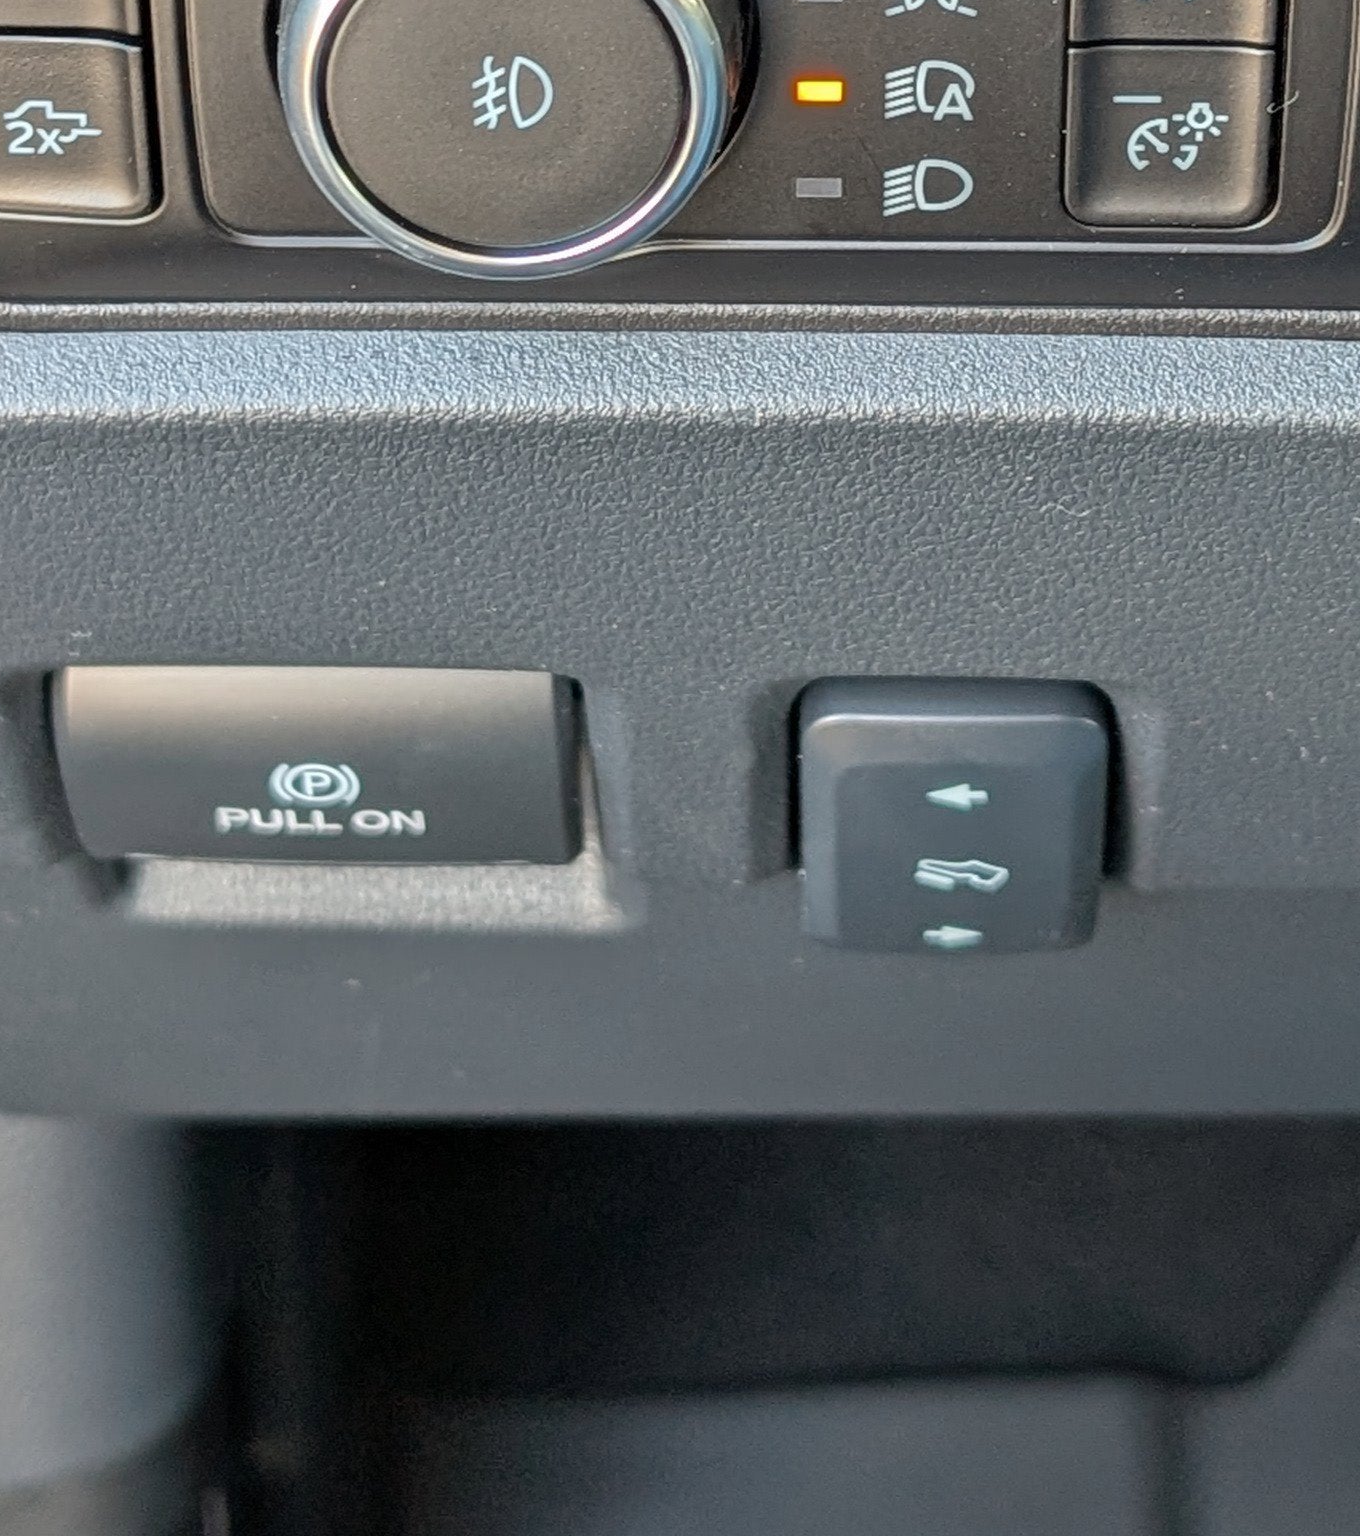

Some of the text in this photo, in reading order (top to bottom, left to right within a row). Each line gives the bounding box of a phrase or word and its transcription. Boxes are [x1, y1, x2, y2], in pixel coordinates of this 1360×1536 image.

[933, 83, 974, 121] A
[5, 120, 64, 155] 2x
[301, 771, 332, 797] P
[214, 806, 427, 837] PULL ON
